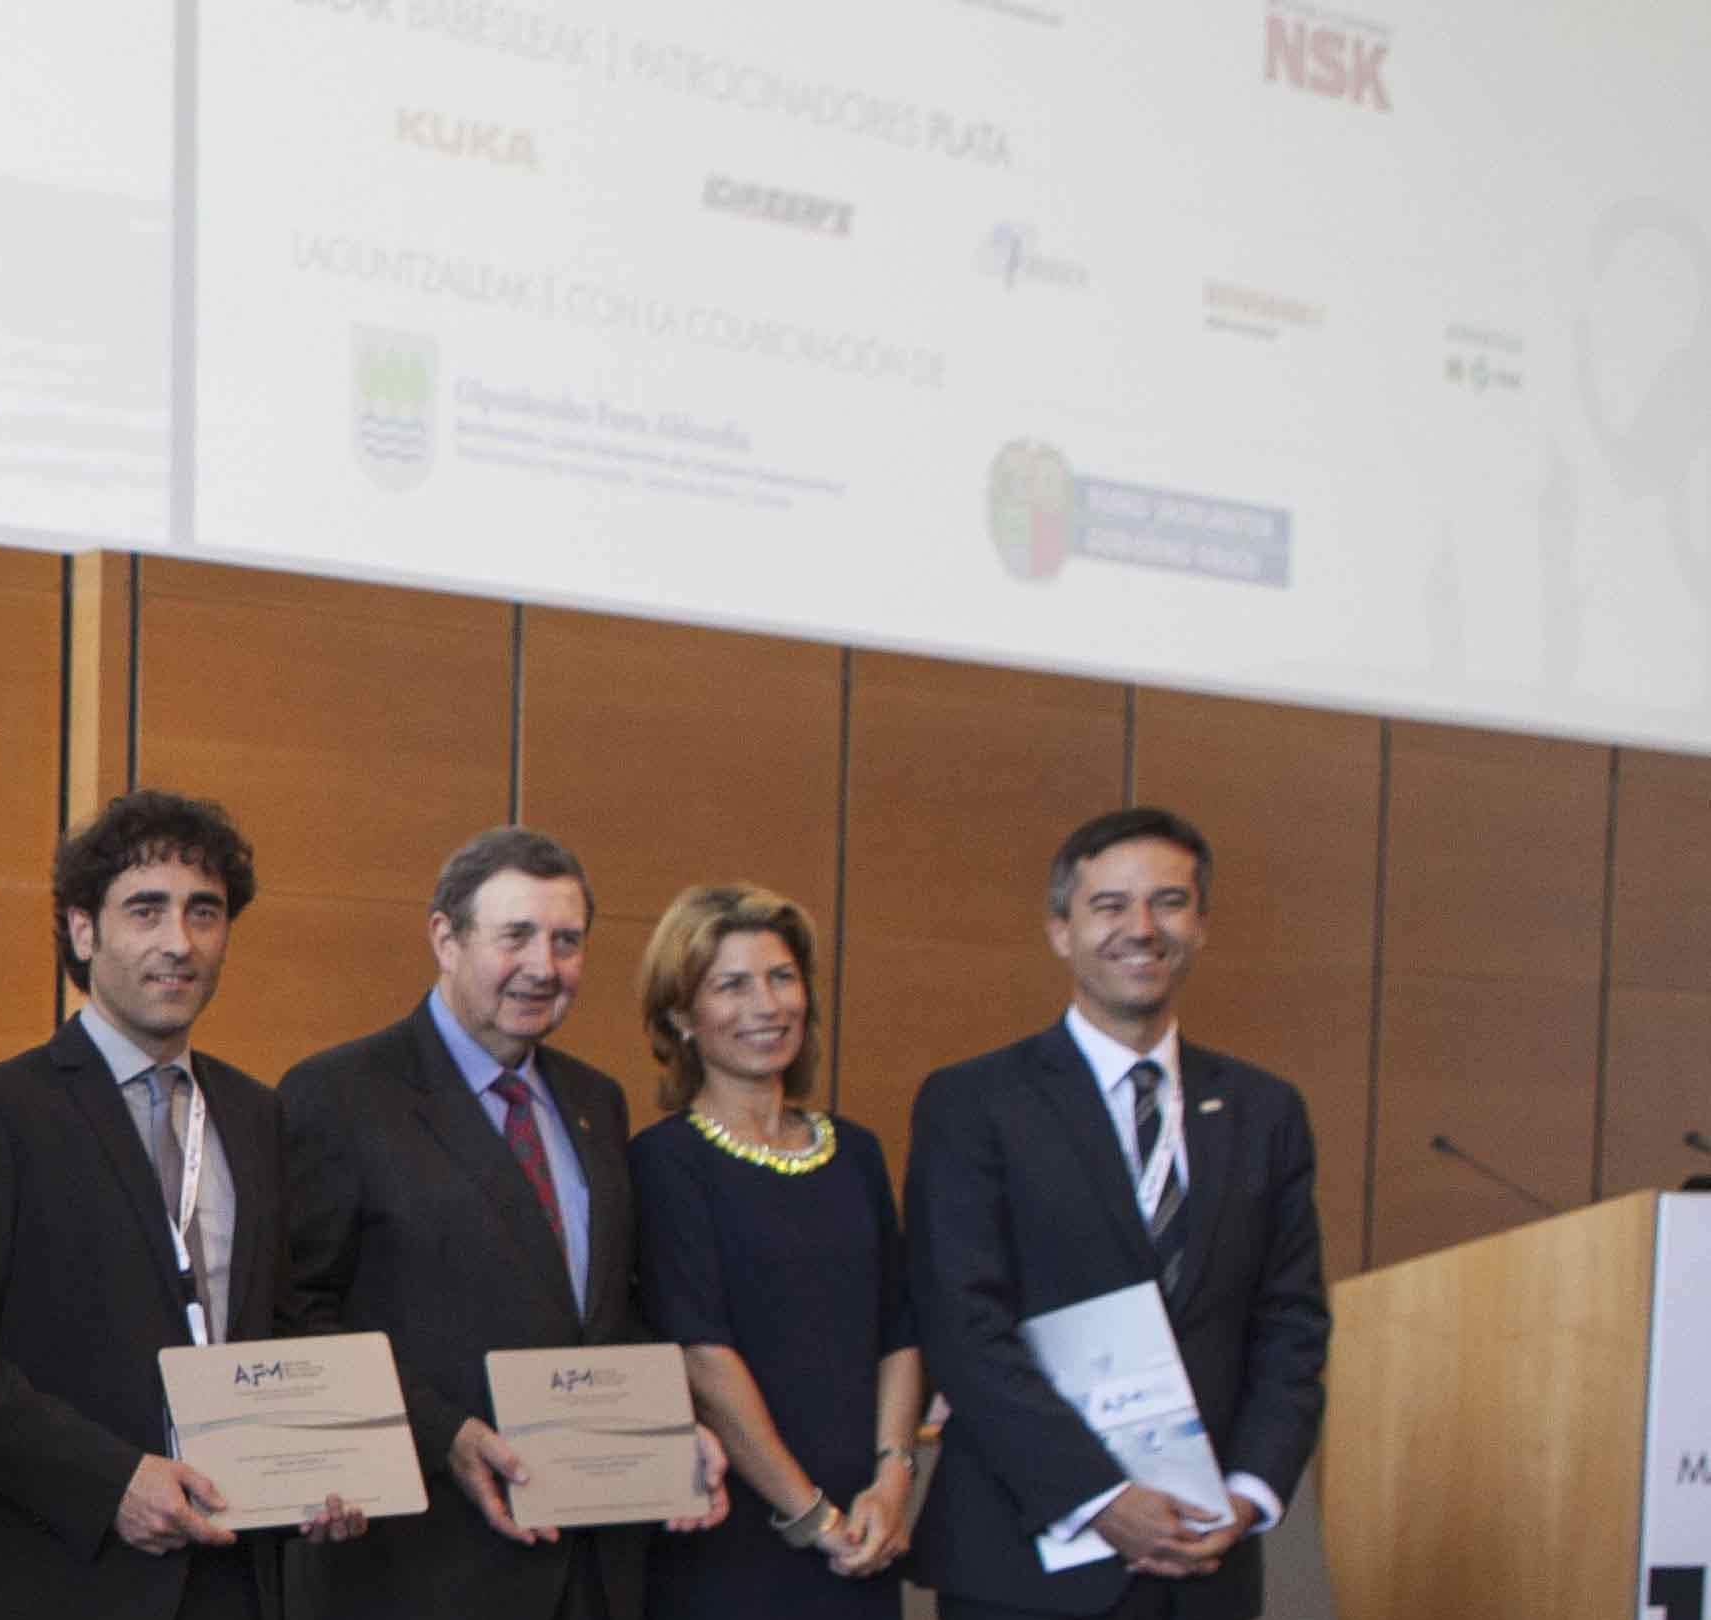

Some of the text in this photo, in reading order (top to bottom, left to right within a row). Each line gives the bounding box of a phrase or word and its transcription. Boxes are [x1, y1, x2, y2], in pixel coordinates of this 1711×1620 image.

[1263, 15, 1393, 114] NSK
[632, 38, 920, 151] PATROCINADORES
[925, 110, 1011, 171] PLATA
[394, 104, 539, 173] KUKA
[234, 1360, 284, 1388] AFM
[550, 1368, 594, 1392] AFM
[1676, 1450, 1711, 1485] M
